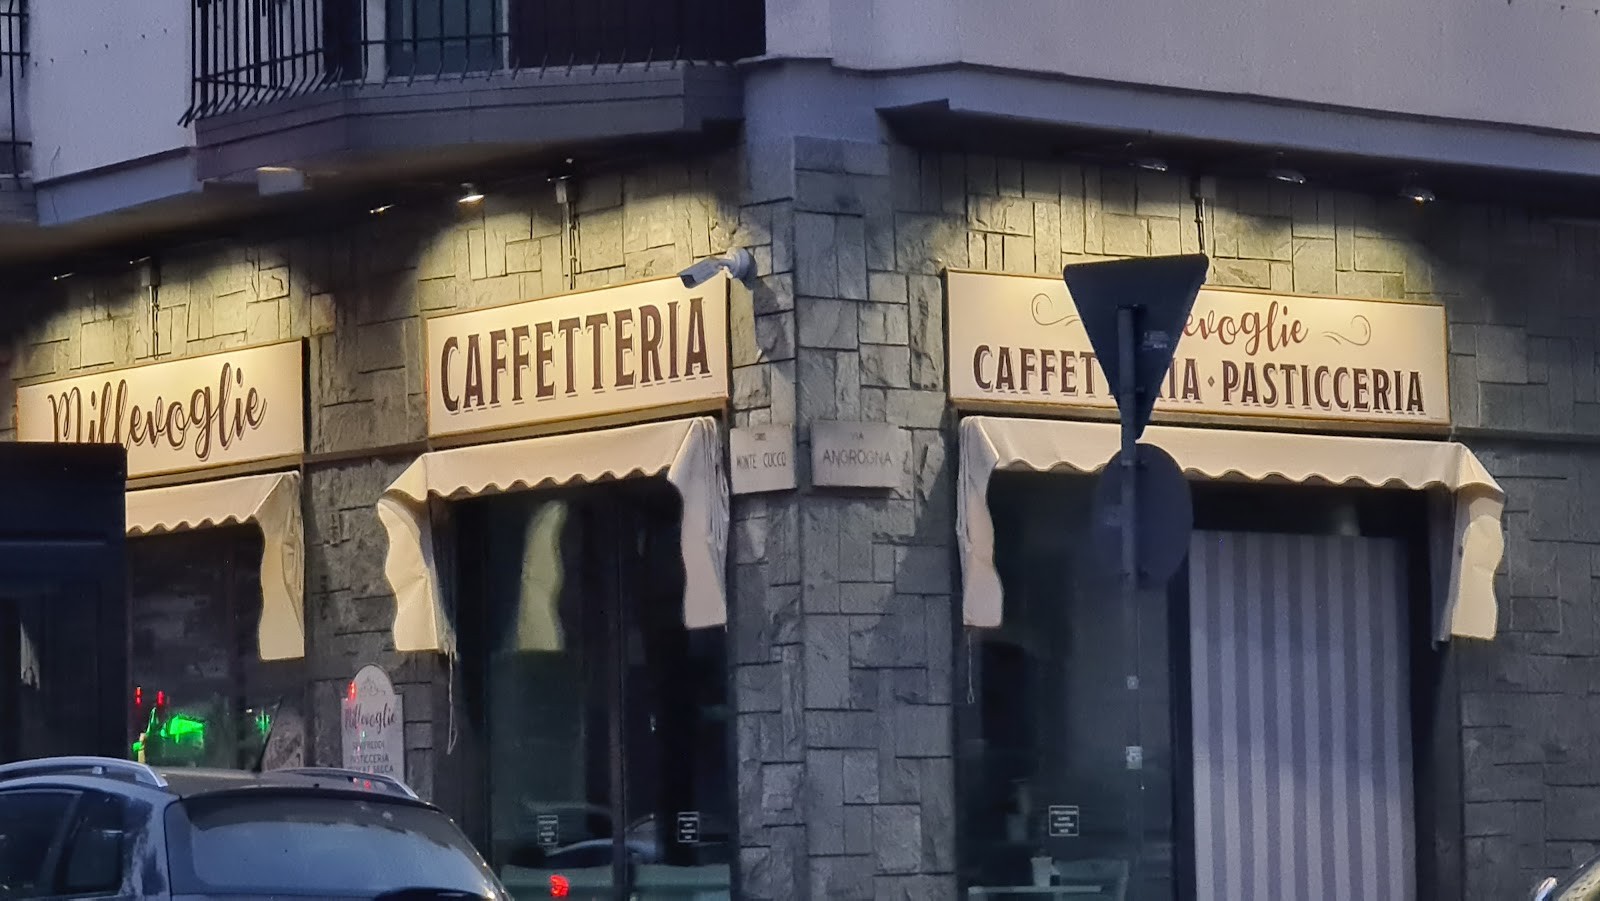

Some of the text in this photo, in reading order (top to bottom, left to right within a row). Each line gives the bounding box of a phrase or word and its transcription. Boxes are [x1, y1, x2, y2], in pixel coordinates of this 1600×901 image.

[440, 297, 711, 414] CAFFETTERIA
[1183, 301, 1308, 356] evoglie
[47, 362, 266, 461] Millevoglie
[973, 344, 1426, 414] CAFFETIA PASTICCERIA
[763, 451, 787, 468] CUCCO
